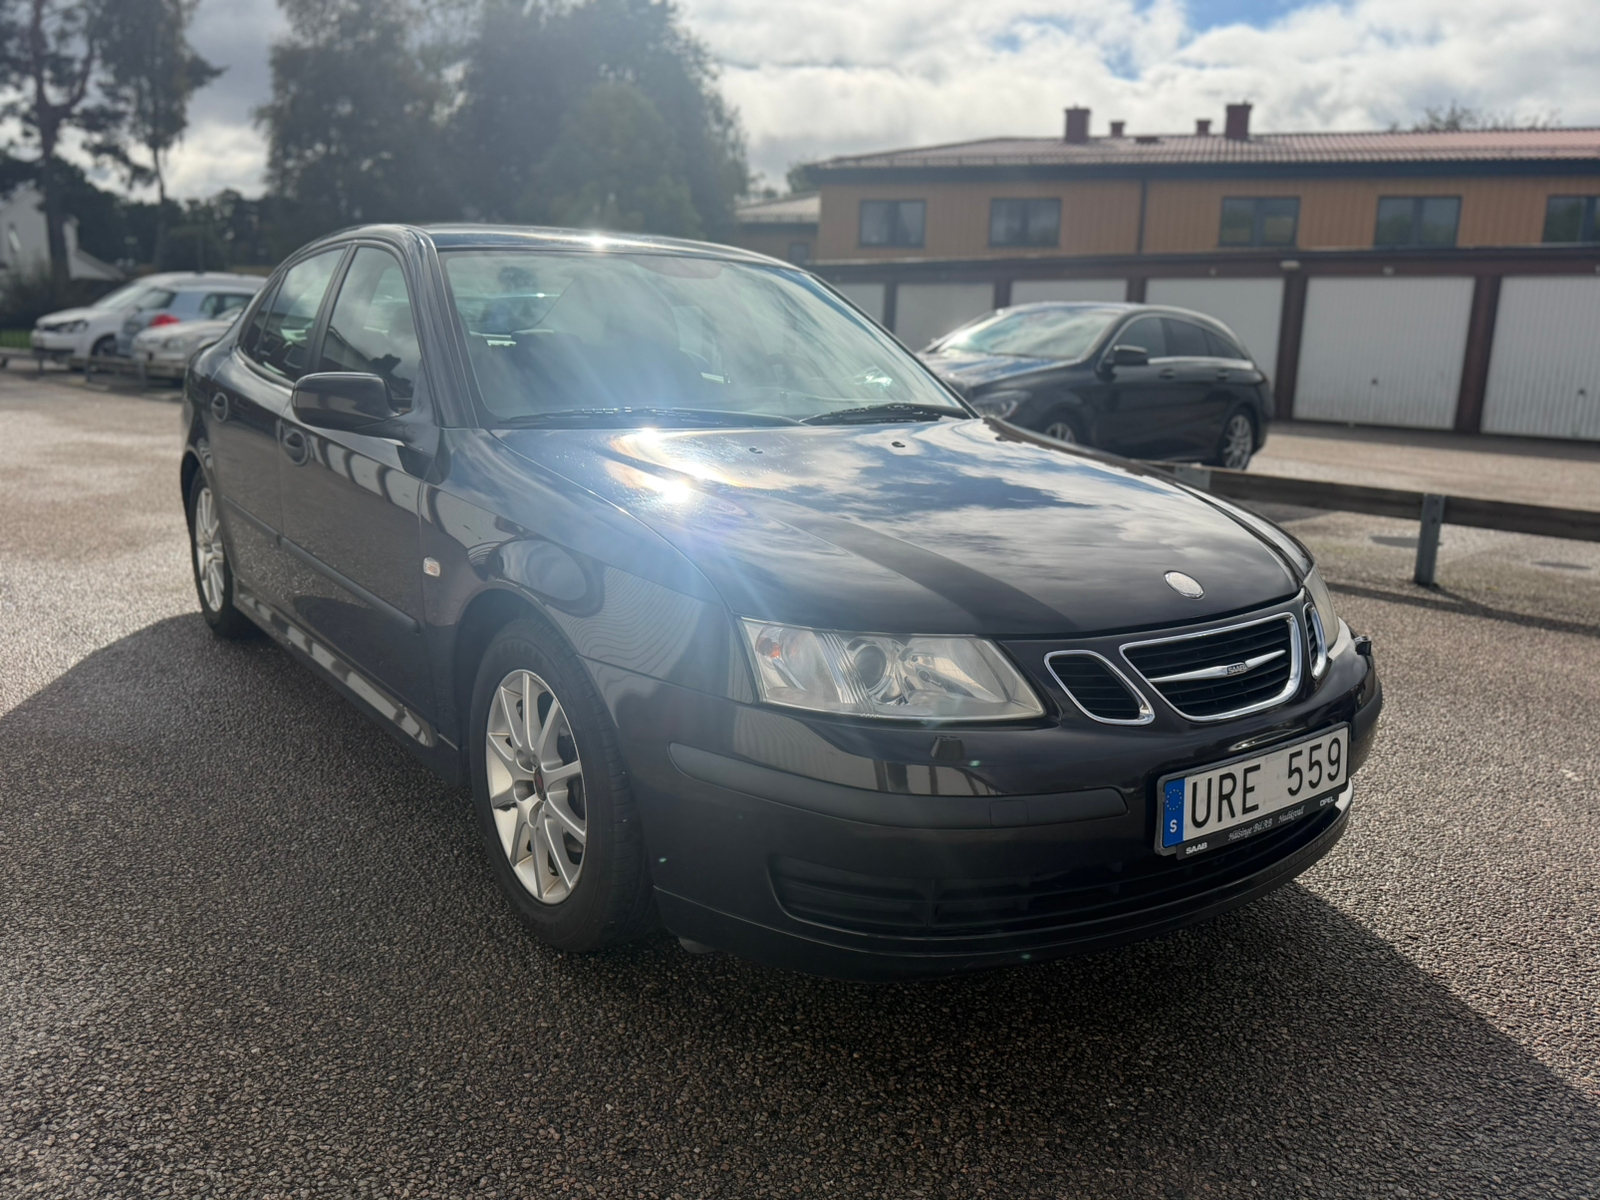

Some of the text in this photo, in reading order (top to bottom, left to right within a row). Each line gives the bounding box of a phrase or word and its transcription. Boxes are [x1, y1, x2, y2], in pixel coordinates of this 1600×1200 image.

[1190, 737, 1341, 829] URE 559
[1319, 796, 1335, 807] OPEL
[1169, 819, 1178, 833] S
[1185, 841, 1208, 855] SAAB
